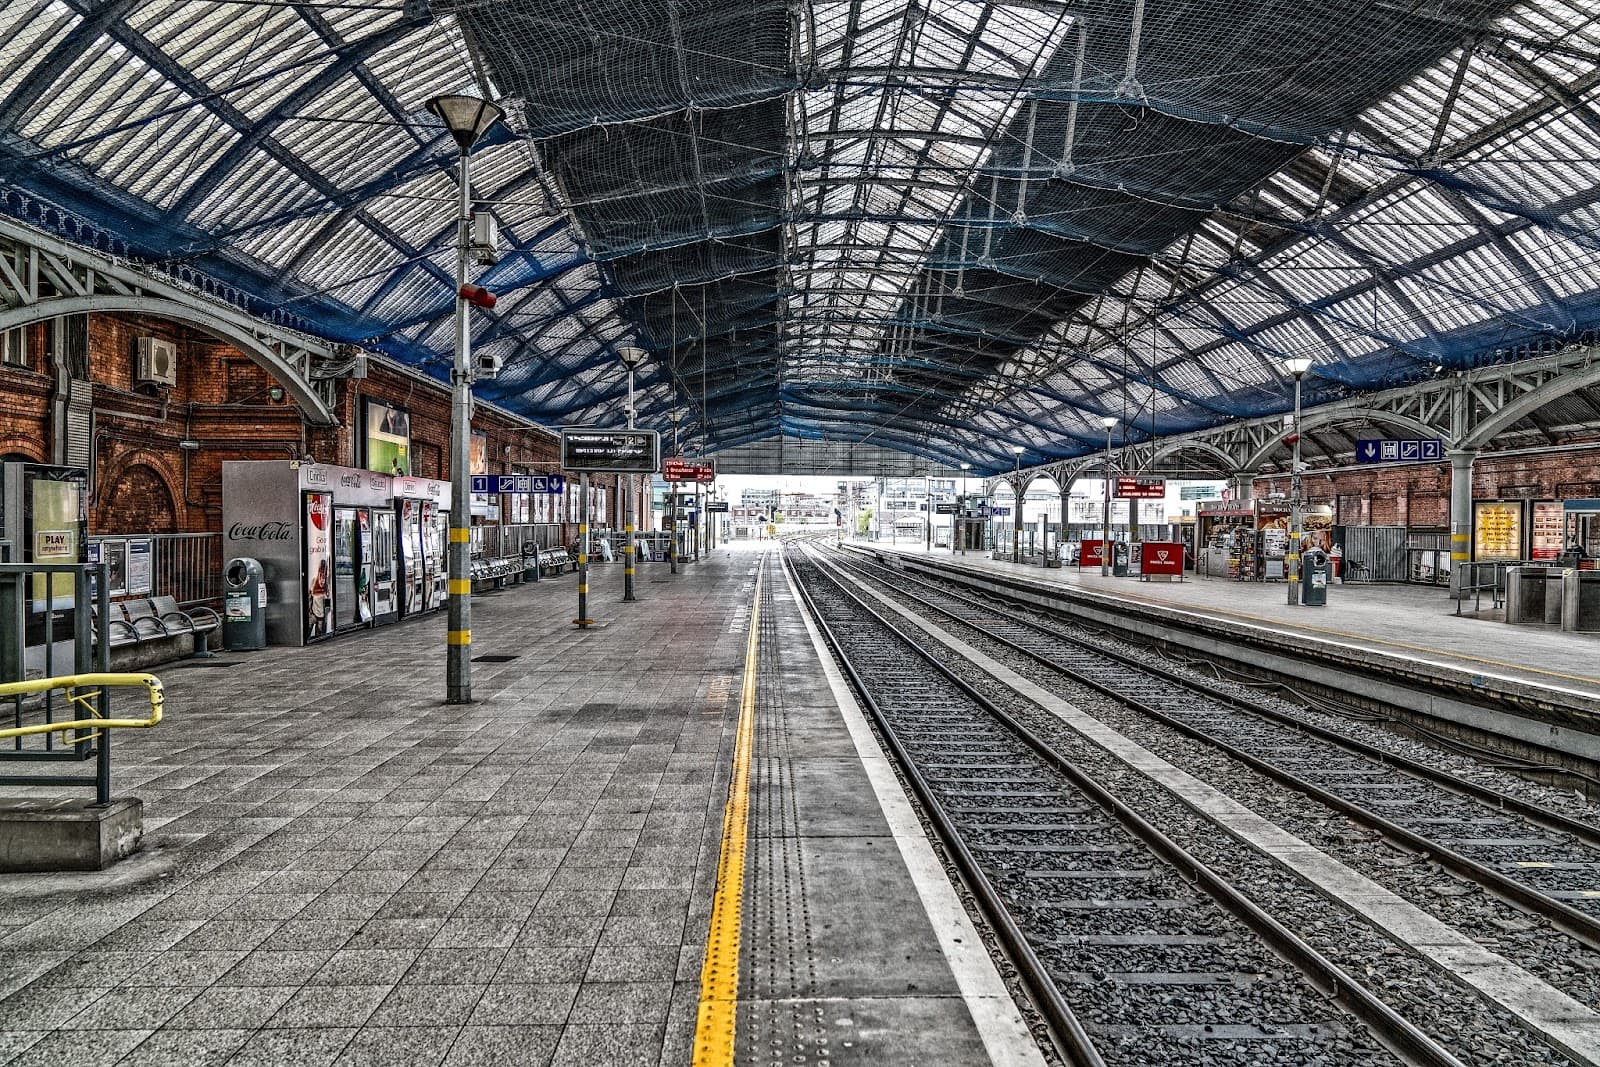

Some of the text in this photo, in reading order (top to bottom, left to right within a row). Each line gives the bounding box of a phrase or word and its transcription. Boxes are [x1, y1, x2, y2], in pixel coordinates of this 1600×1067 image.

[1425, 443, 1435, 456] 2
[476, 478, 483, 490] 1
[229, 522, 294, 540] Coca-Cola
[45, 535, 65, 544] PLAY
